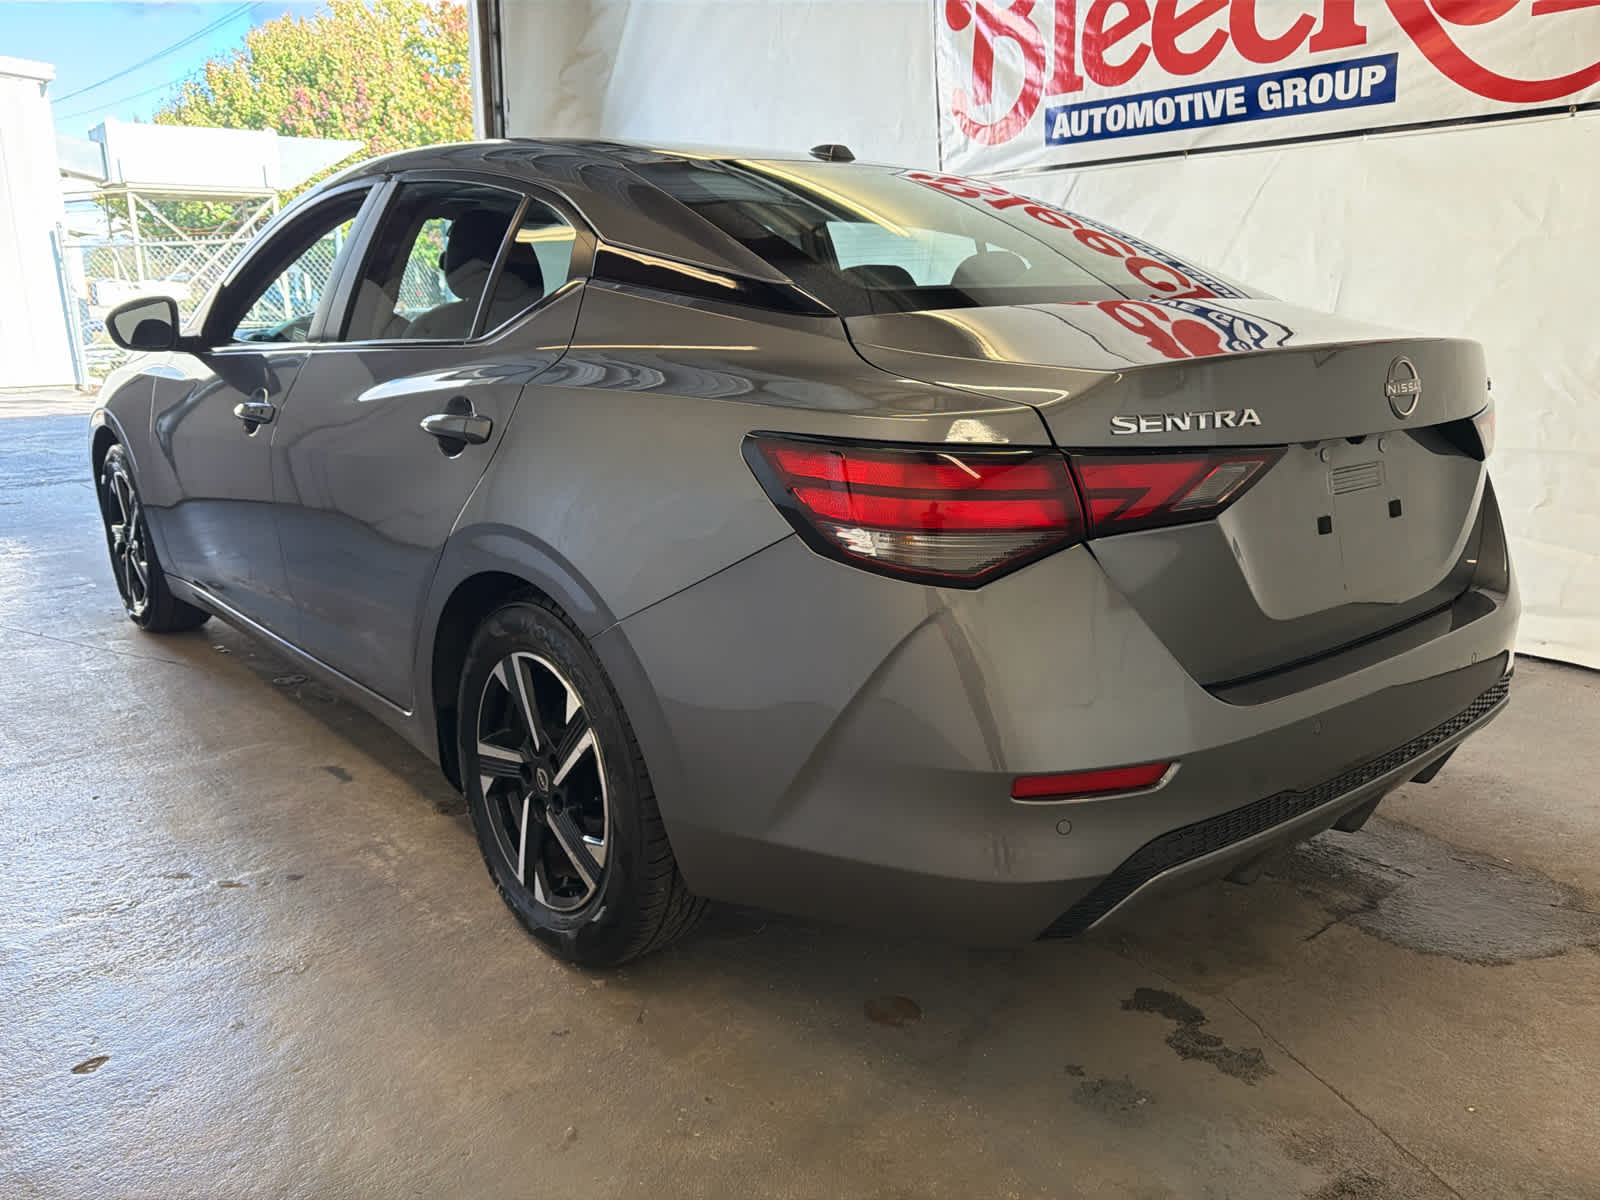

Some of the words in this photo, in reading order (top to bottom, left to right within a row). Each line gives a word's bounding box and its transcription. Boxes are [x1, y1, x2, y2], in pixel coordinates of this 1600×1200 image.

[1051, 86, 1247, 139] AUTOMOTIVE
[1258, 64, 1387, 112] GROUP
[1111, 408, 1262, 435] SENTRA
